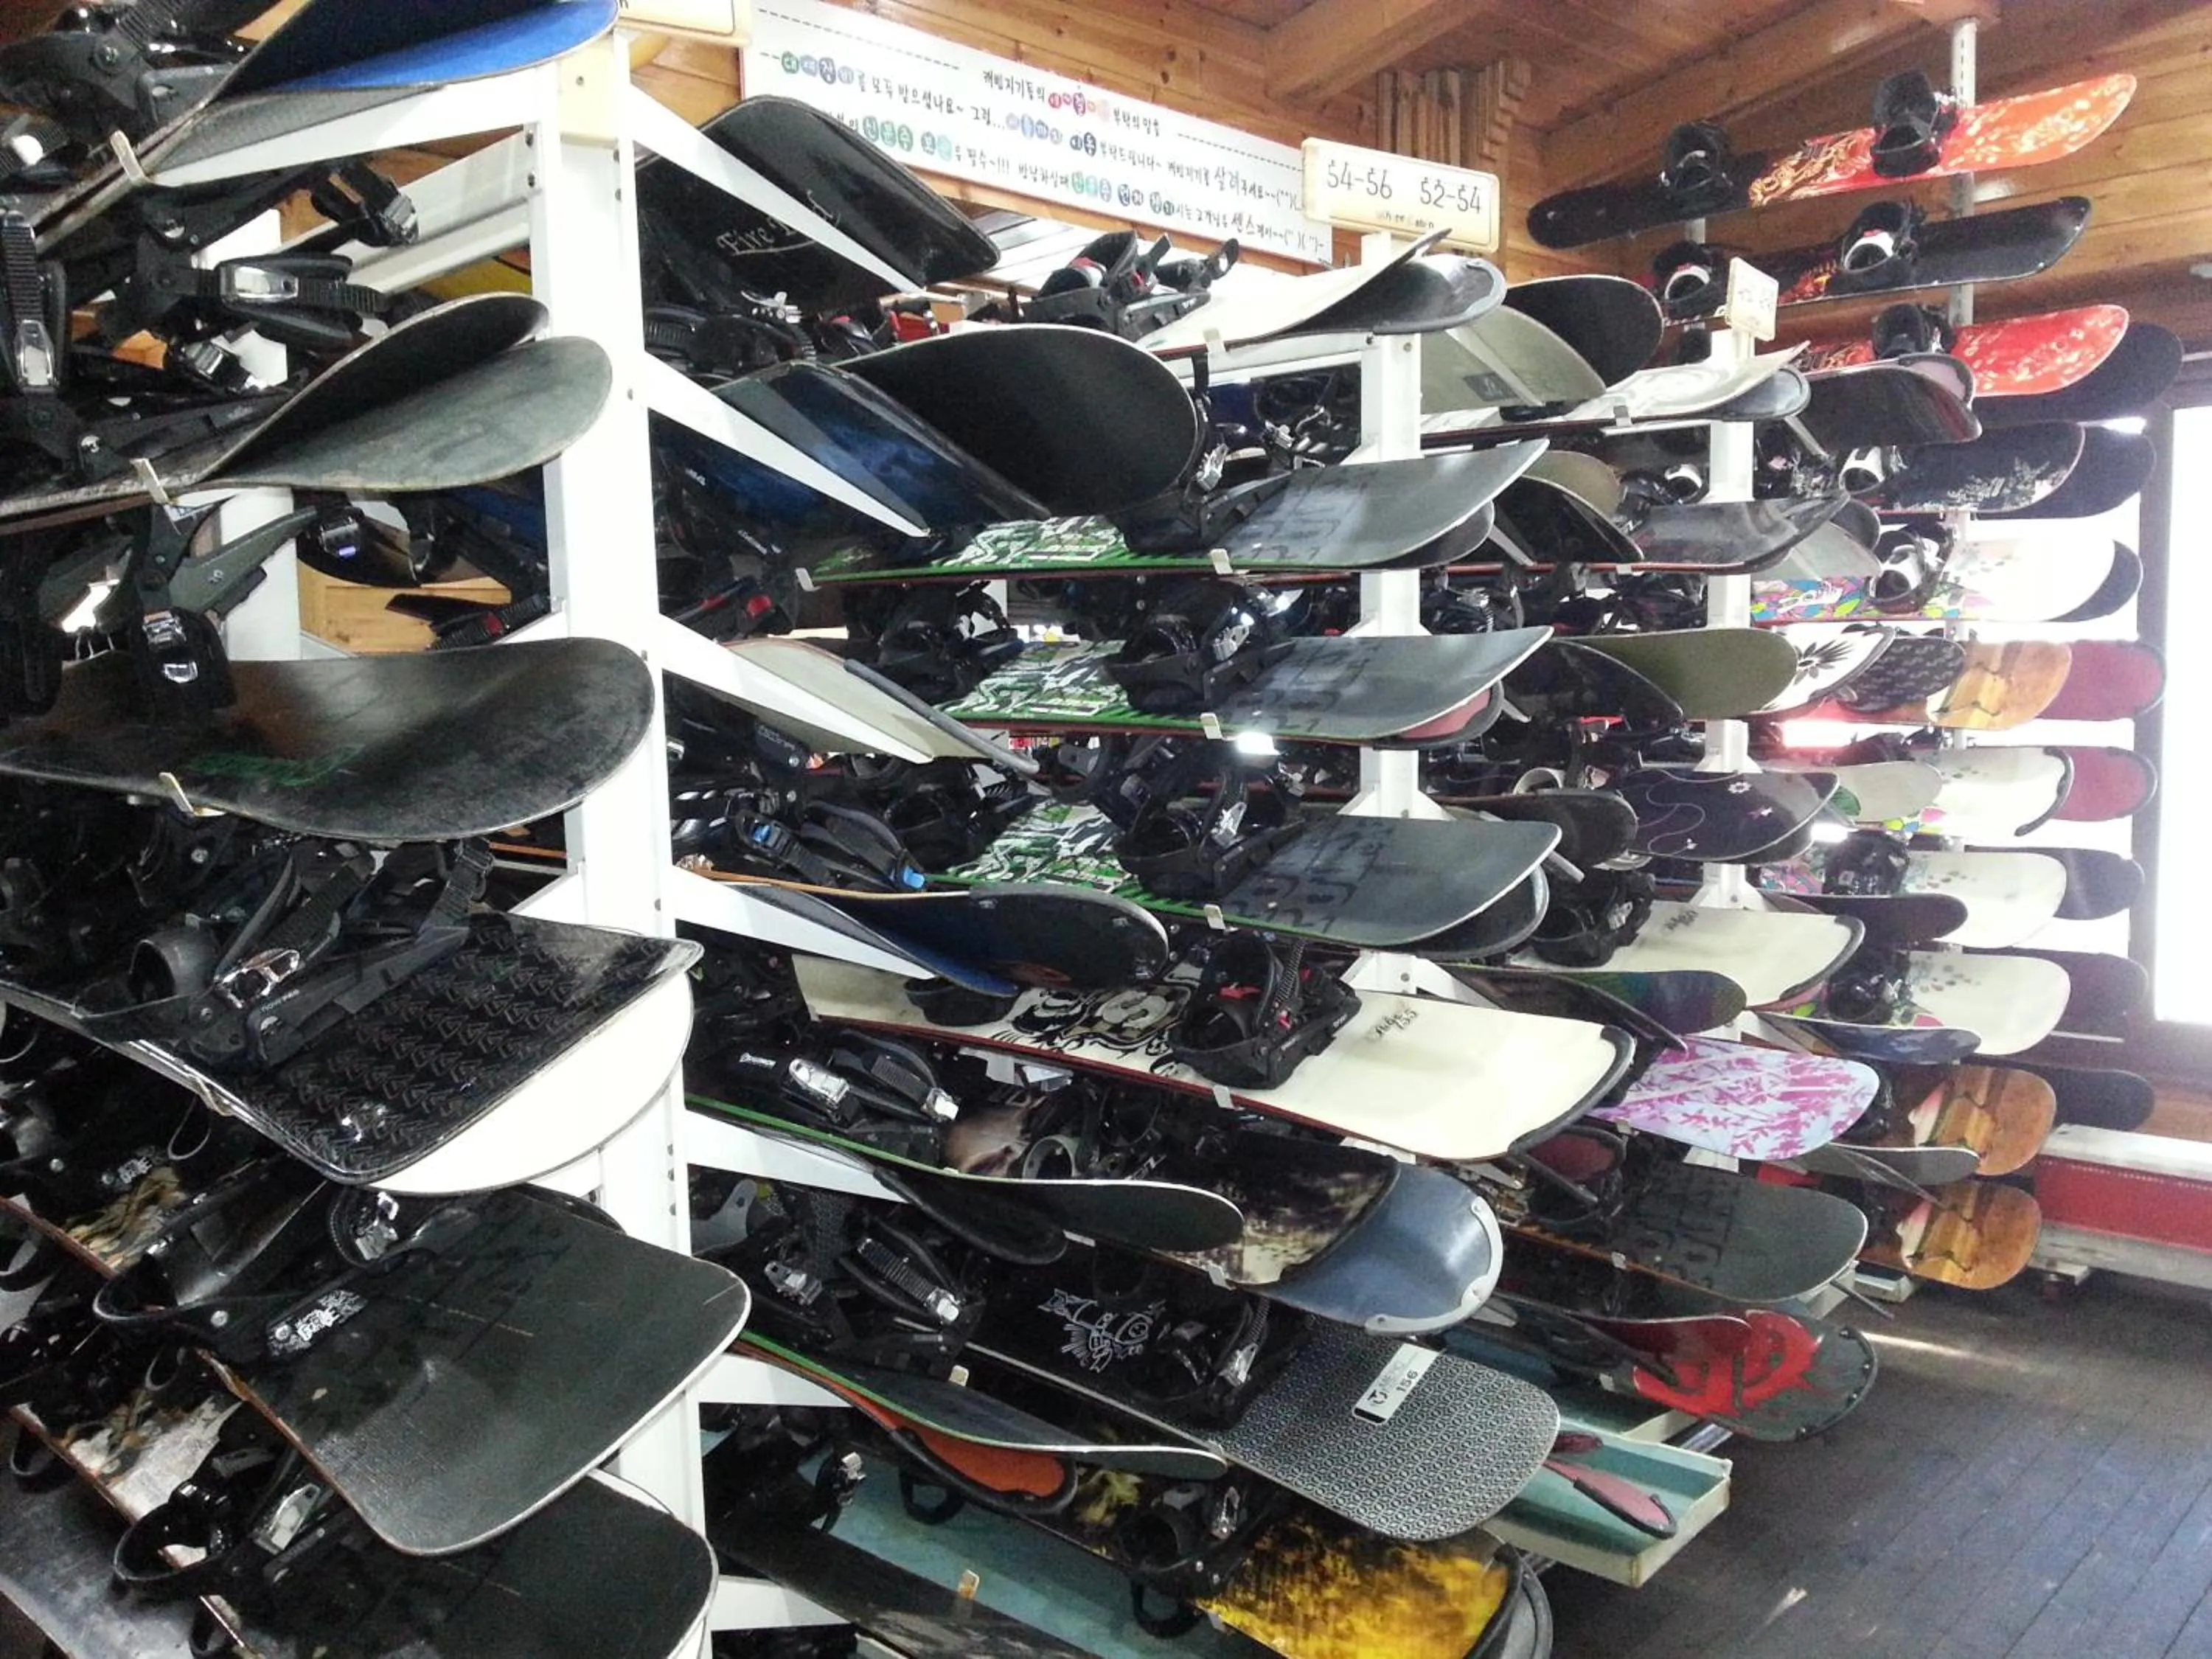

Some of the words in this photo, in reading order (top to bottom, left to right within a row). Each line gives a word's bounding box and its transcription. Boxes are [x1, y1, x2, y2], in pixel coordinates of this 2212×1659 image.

[872, 77, 893, 100] 모두
[1328, 159, 1393, 199] 54-56
[1419, 176, 1481, 214] 52-54
[1396, 1371, 1418, 1392] 156
